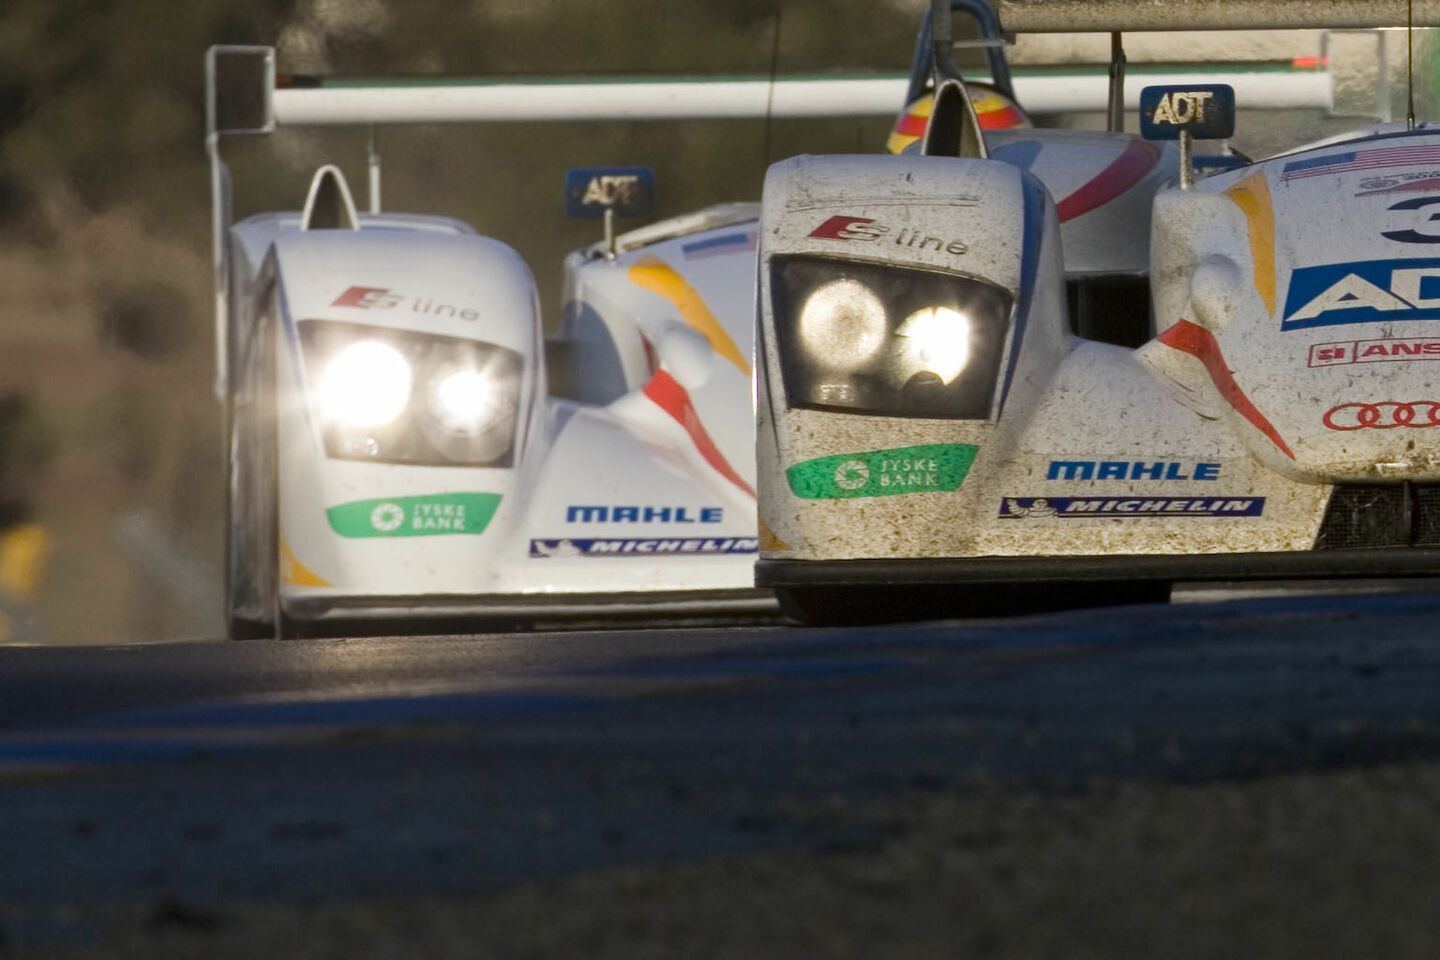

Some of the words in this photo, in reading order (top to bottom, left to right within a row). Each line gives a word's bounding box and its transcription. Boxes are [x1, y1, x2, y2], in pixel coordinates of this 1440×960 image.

[1152, 91, 1213, 124] ADT
[581, 175, 638, 205] ADT
[895, 229, 969, 256] line
[411, 297, 481, 322] line
[880, 459, 938, 472] JYSKE
[1047, 461, 1221, 480] MAHLE
[880, 473, 938, 486] BANK
[566, 506, 723, 523] MAHLE
[1064, 500, 1253, 512] MICHELIN
[413, 517, 465, 530] BANK
[588, 539, 758, 553] MICHELIN
